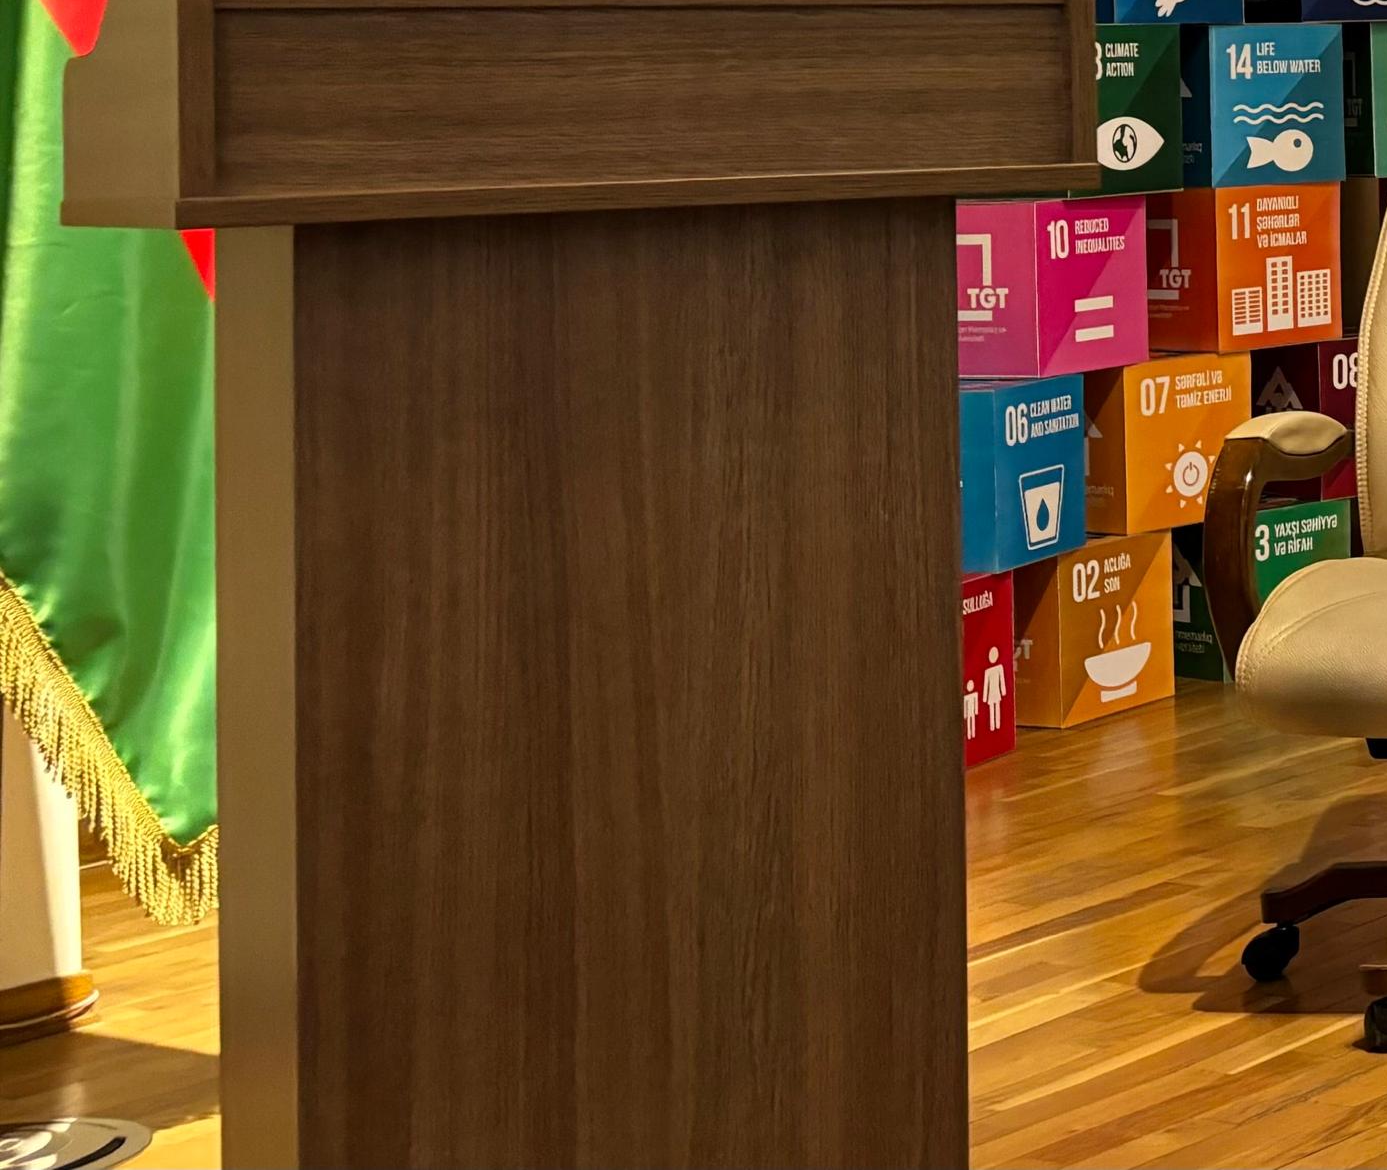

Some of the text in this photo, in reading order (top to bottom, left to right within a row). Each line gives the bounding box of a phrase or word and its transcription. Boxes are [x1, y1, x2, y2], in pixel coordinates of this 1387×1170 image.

[1105, 43, 1139, 58] CLIMATE
[1226, 42, 1275, 79] 14 LIFE
[1106, 62, 1134, 77] ACTION
[1256, 59, 1321, 74] BELOW WATER
[1228, 196, 1299, 240] 11 DAYANIQLI
[1256, 213, 1300, 232] ŞƏHƏRLƏR
[1047, 218, 1109, 259] 10 REDUCED
[1075, 236, 1125, 254] INEQUALITIES
[1257, 230, 1307, 248] VƏ İCMALAR
[1159, 269, 1191, 288] TGT
[967, 287, 1009, 309] TGT
[1332, 352, 1358, 390] 08
[1140, 370, 1223, 417] 07 SƏRFƏLİ VƏ
[1176, 385, 1232, 409] TƏMİZ ENERJİ
[1005, 394, 1072, 446] 06 CLEAN WATER
[1031, 413, 1079, 438] AND SANITATION
[1255, 514, 1338, 562] 3 YAXŞI SƏHİYYƏ
[1274, 541, 1286, 556] VƏ
[1072, 553, 1131, 603] 02 ACLIĞA
[1104, 577, 1120, 594] SON
